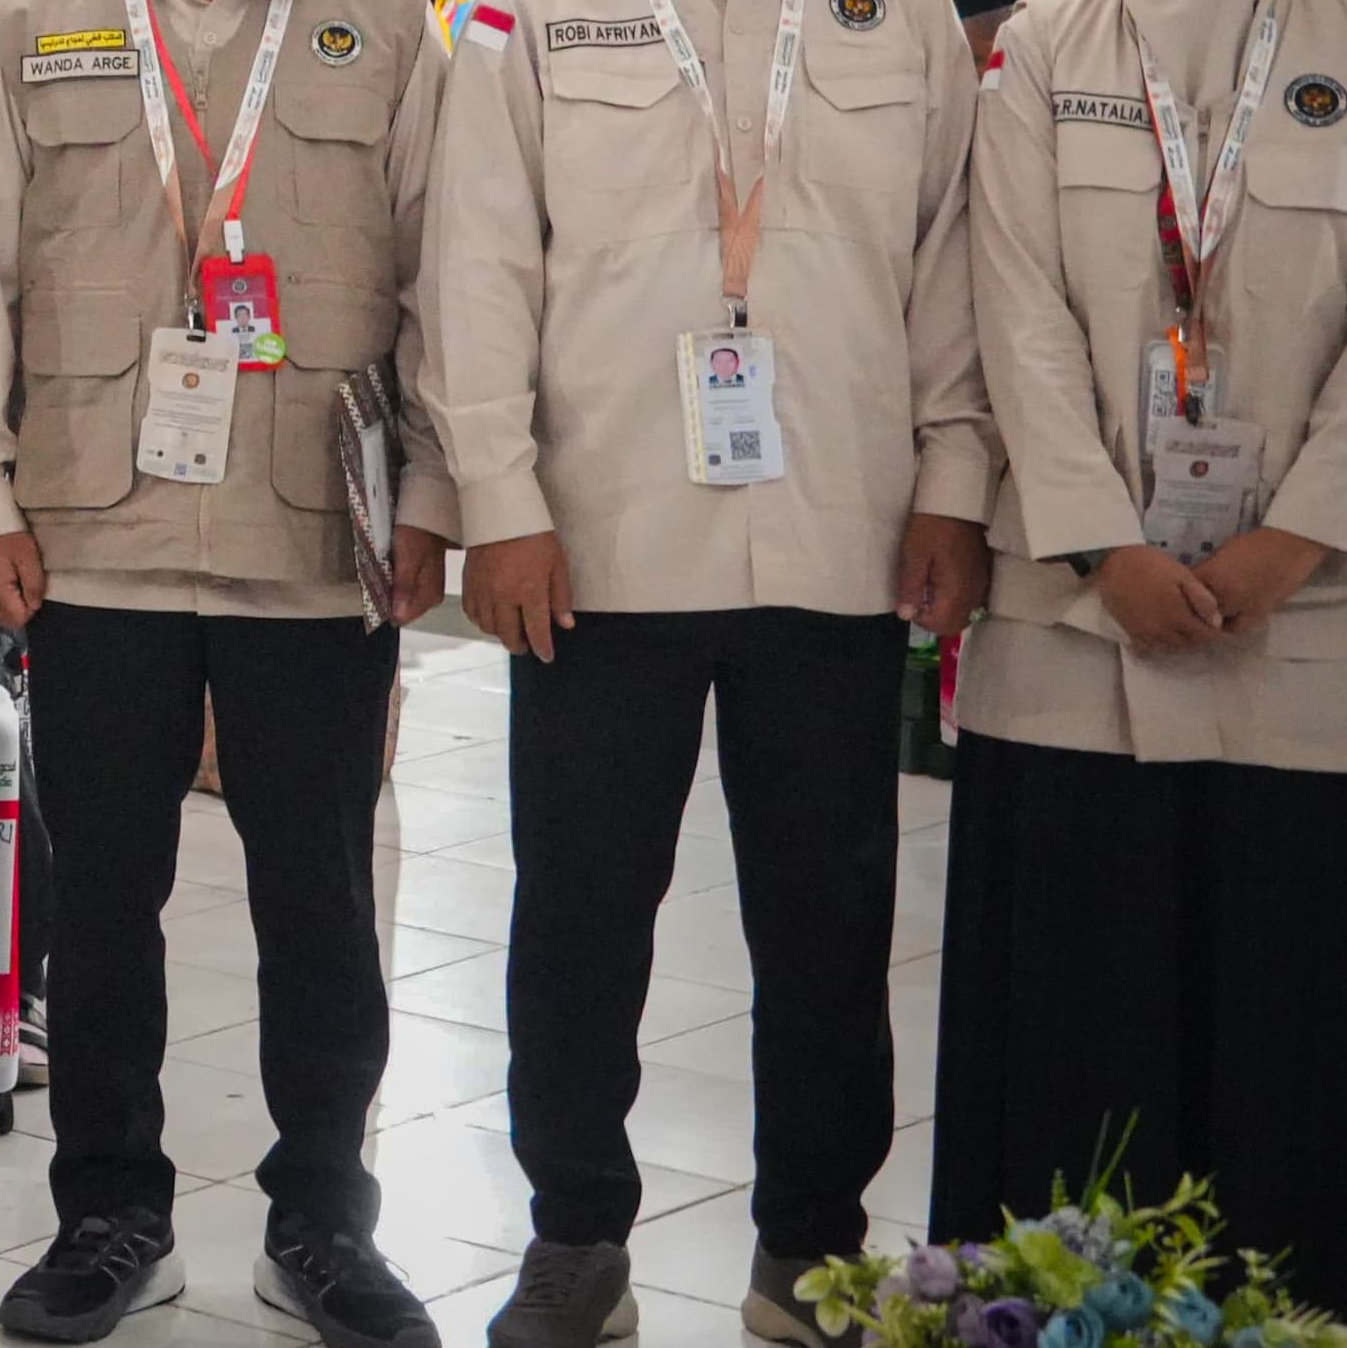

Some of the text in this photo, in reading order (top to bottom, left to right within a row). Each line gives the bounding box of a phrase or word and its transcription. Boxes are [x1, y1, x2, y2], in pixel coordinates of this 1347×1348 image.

[555, 24, 590, 44] ROBI
[30, 56, 132, 75] WANDA ARGE
